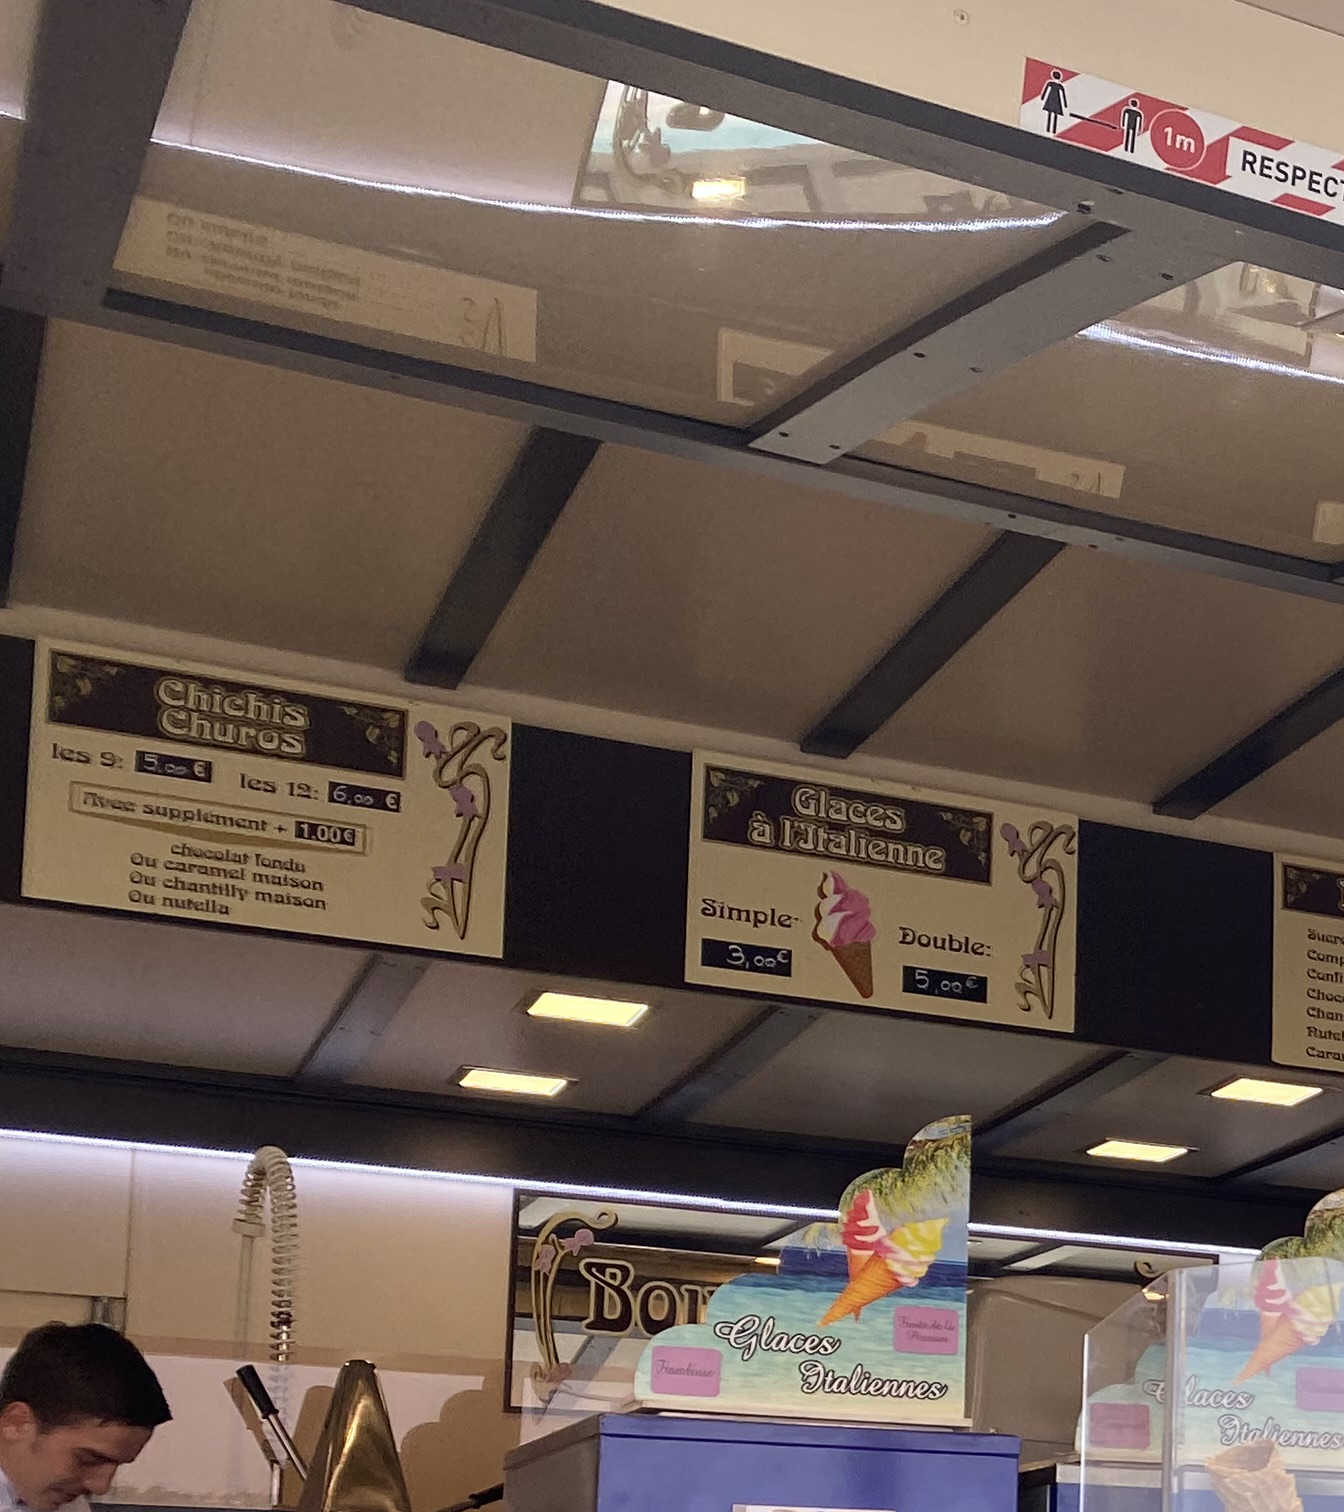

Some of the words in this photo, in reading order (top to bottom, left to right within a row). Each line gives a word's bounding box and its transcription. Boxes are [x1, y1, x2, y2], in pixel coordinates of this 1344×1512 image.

[1164, 126, 1195, 153] 1m
[155, 676, 310, 730] Chichis
[157, 706, 305, 756] Churos
[51, 743, 90, 764] les
[100, 751, 124, 769] 9:
[240, 773, 276, 793] les
[288, 781, 320, 800] 12:
[793, 786, 906, 833] Glaces
[170, 843, 249, 864] chocolat
[255, 853, 306, 873] fondu
[747, 812, 774, 846] à
[781, 815, 946, 873] l'Italienne
[129, 871, 157, 886] Ou
[162, 876, 248, 900] chantilly
[255, 890, 327, 910] maison
[130, 852, 157, 868] Ou
[164, 859, 244, 881] caramel
[252, 871, 323, 891] maison
[128, 890, 156, 905] Ou
[161, 895, 230, 915] nutella
[898, 926, 992, 957] Double:
[579, 1258, 718, 1337] Bou
[714, 1314, 841, 1361] Glaces
[799, 1360, 948, 1401] Italiennes
